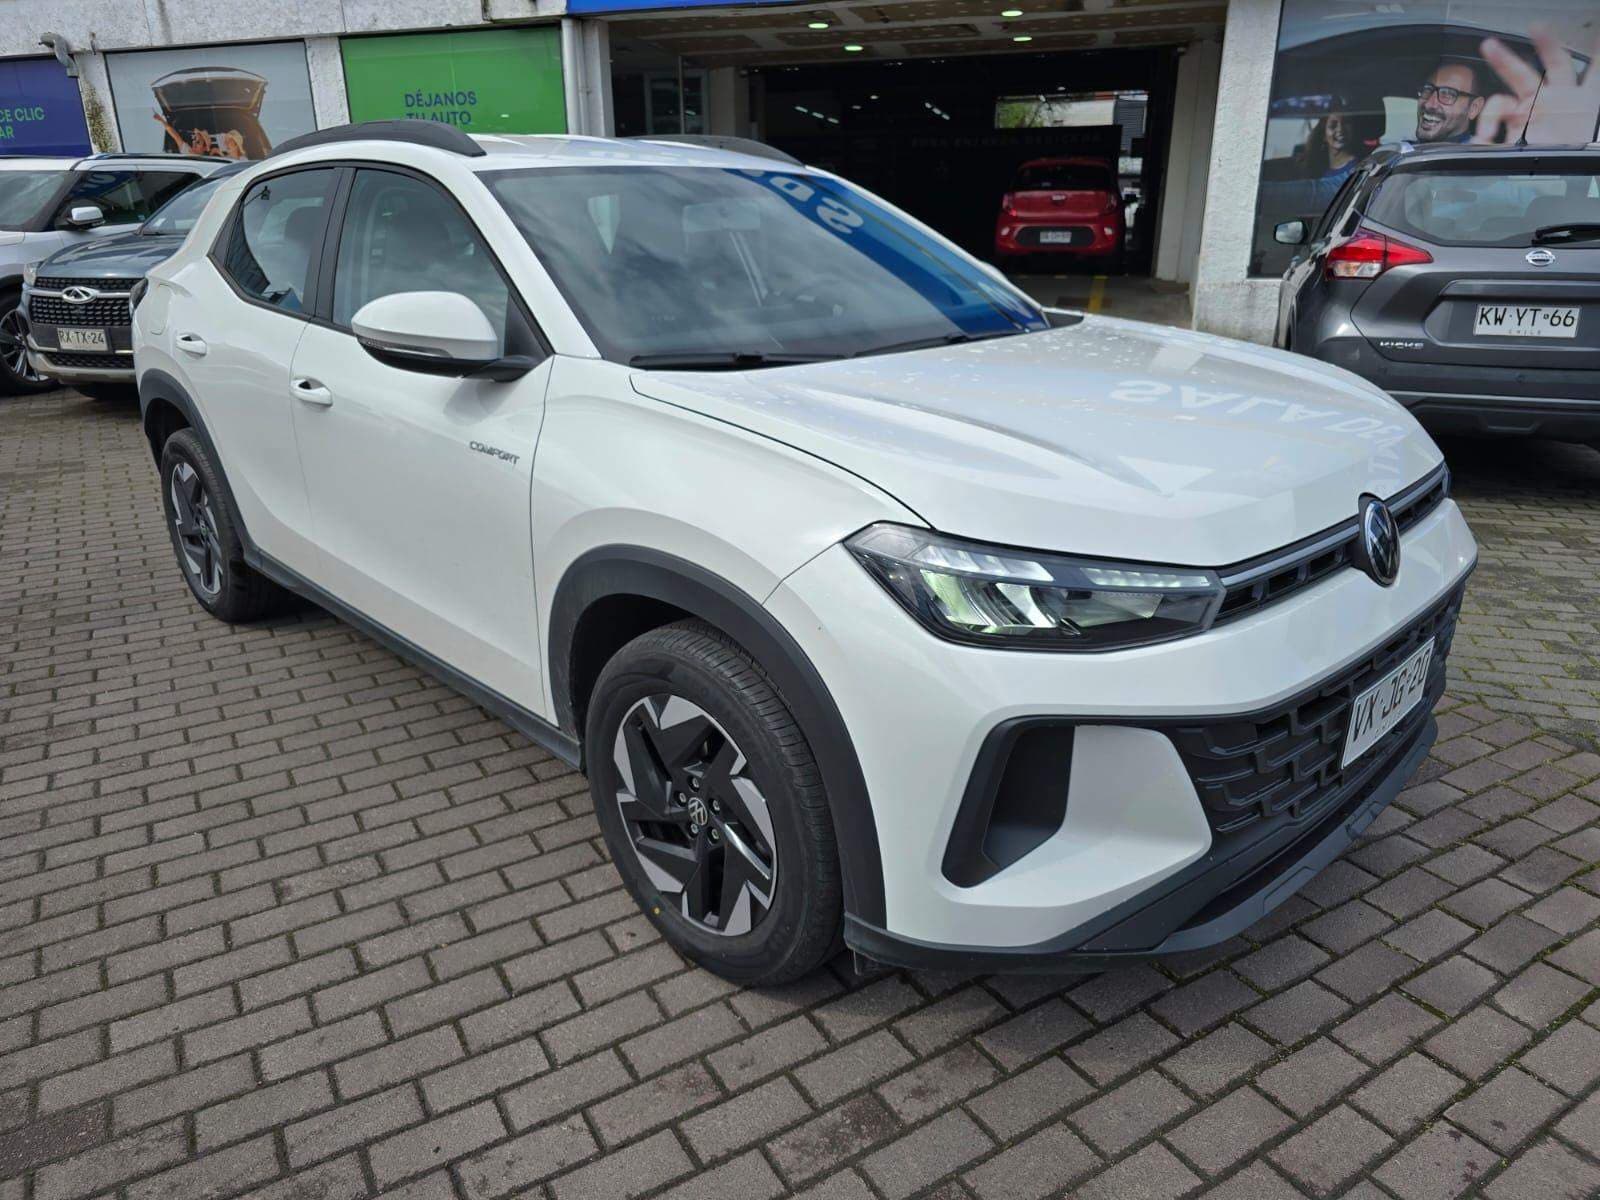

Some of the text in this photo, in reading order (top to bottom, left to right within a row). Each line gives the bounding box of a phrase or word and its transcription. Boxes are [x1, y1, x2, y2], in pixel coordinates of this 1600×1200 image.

[404, 88, 477, 107] DÉJANOS
[15, 107, 45, 121] CLIC
[431, 111, 471, 125] AUTO
[469, 440, 520, 464] COMFORT
